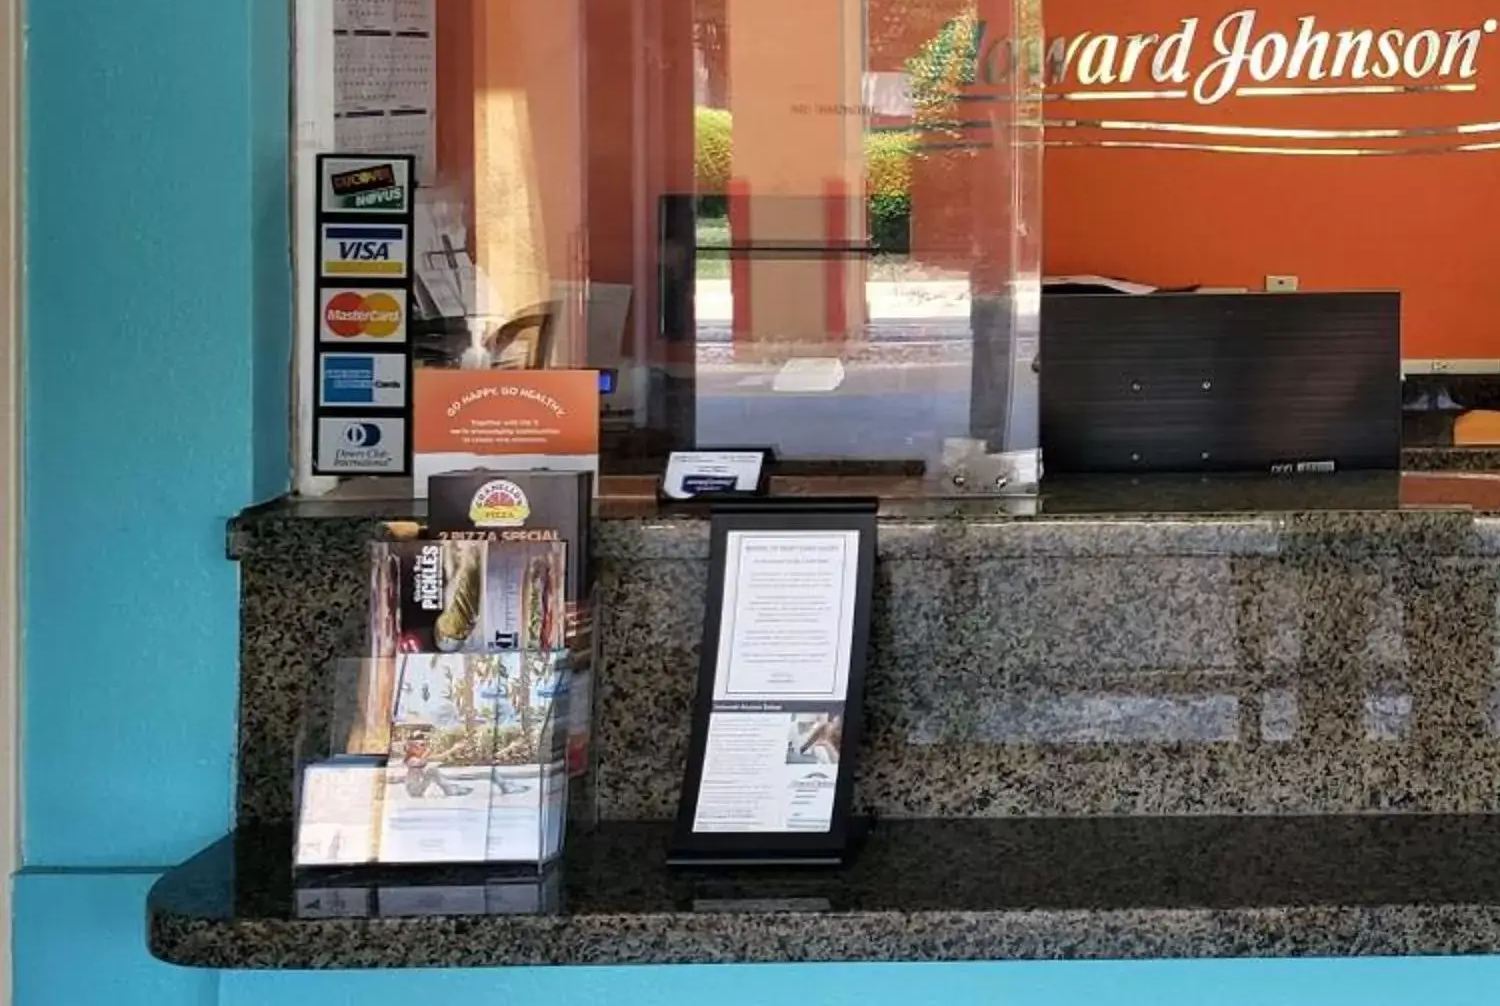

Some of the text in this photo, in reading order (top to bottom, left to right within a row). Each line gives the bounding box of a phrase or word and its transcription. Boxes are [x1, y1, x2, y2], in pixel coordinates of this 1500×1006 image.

[1193, 8, 1486, 105] Johnson
[355, 187, 402, 207] NOVUS
[339, 241, 390, 261] VISA
[327, 309, 400, 322] MasterCard
[485, 511, 516, 519] PIZZA
[452, 531, 498, 541] PIZZA
[501, 530, 561, 541] SPECIAL
[420, 545, 440, 611] PICKLES
